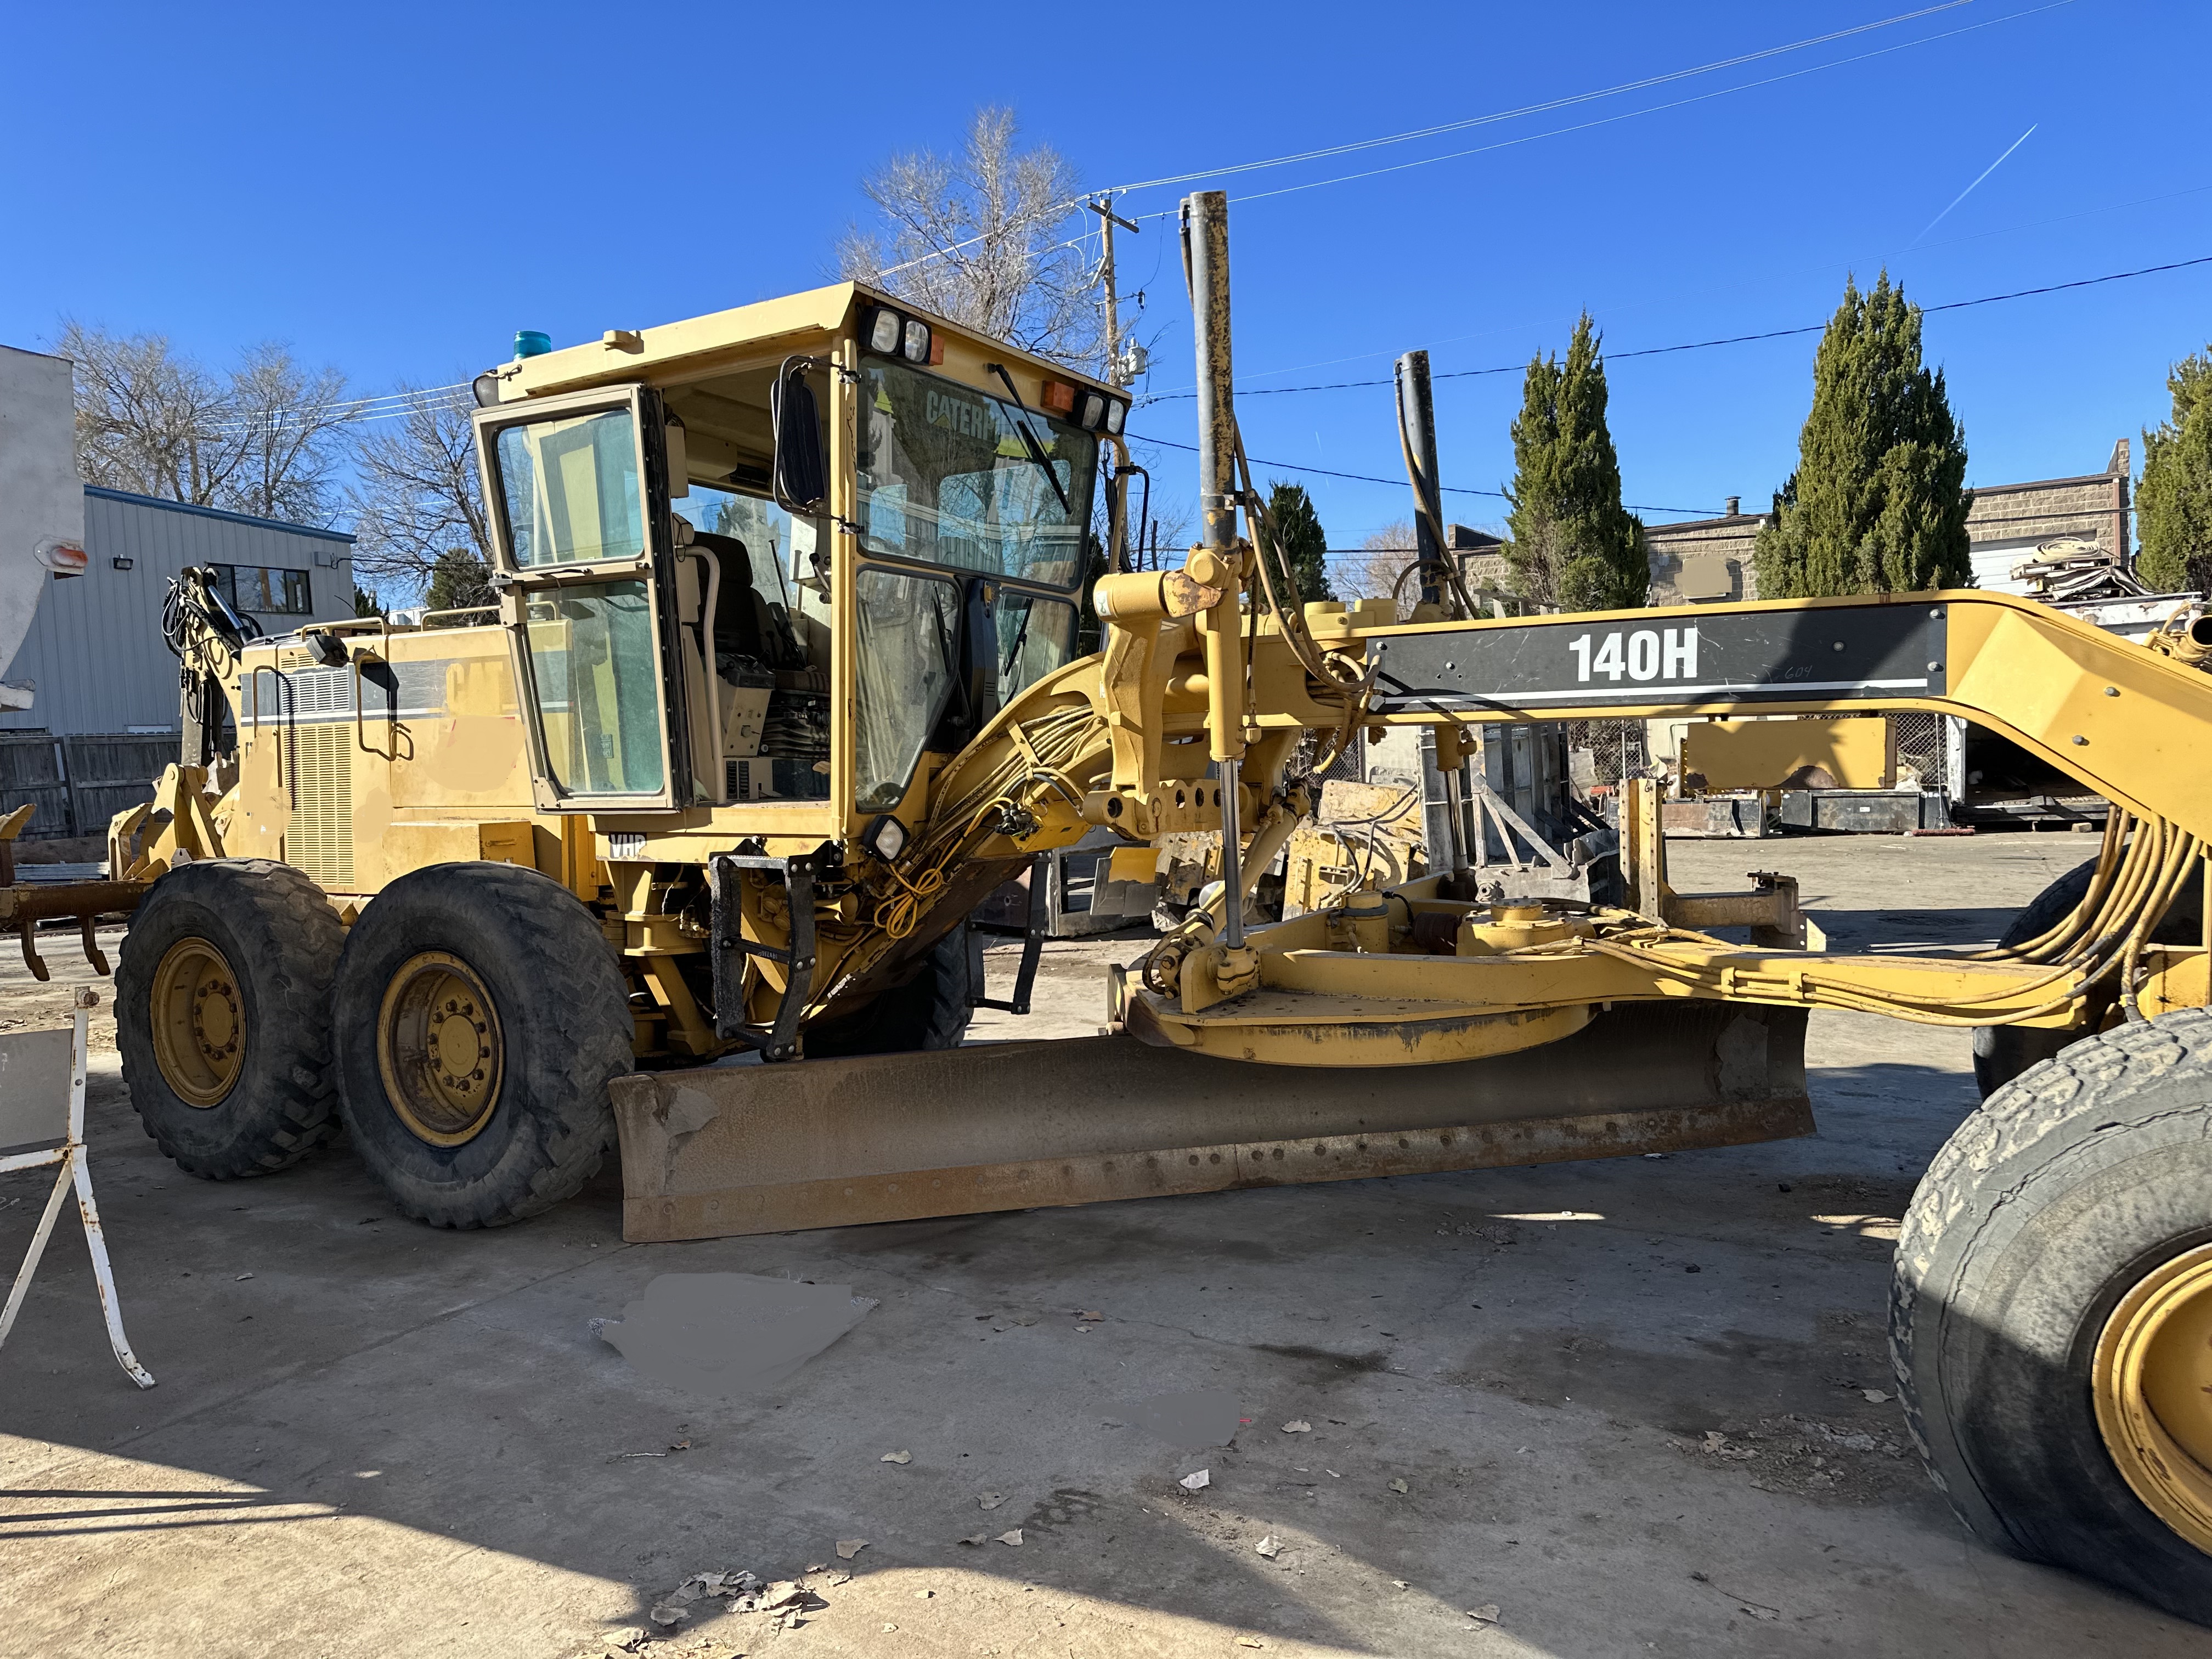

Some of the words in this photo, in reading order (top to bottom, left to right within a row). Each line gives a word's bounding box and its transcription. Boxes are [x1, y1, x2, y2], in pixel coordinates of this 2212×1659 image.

[926, 390, 1040, 452] CATERPILL
[1569, 628, 1697, 681] 140H
[1785, 665, 1812, 679] 604
[611, 834, 646, 858] VHP
